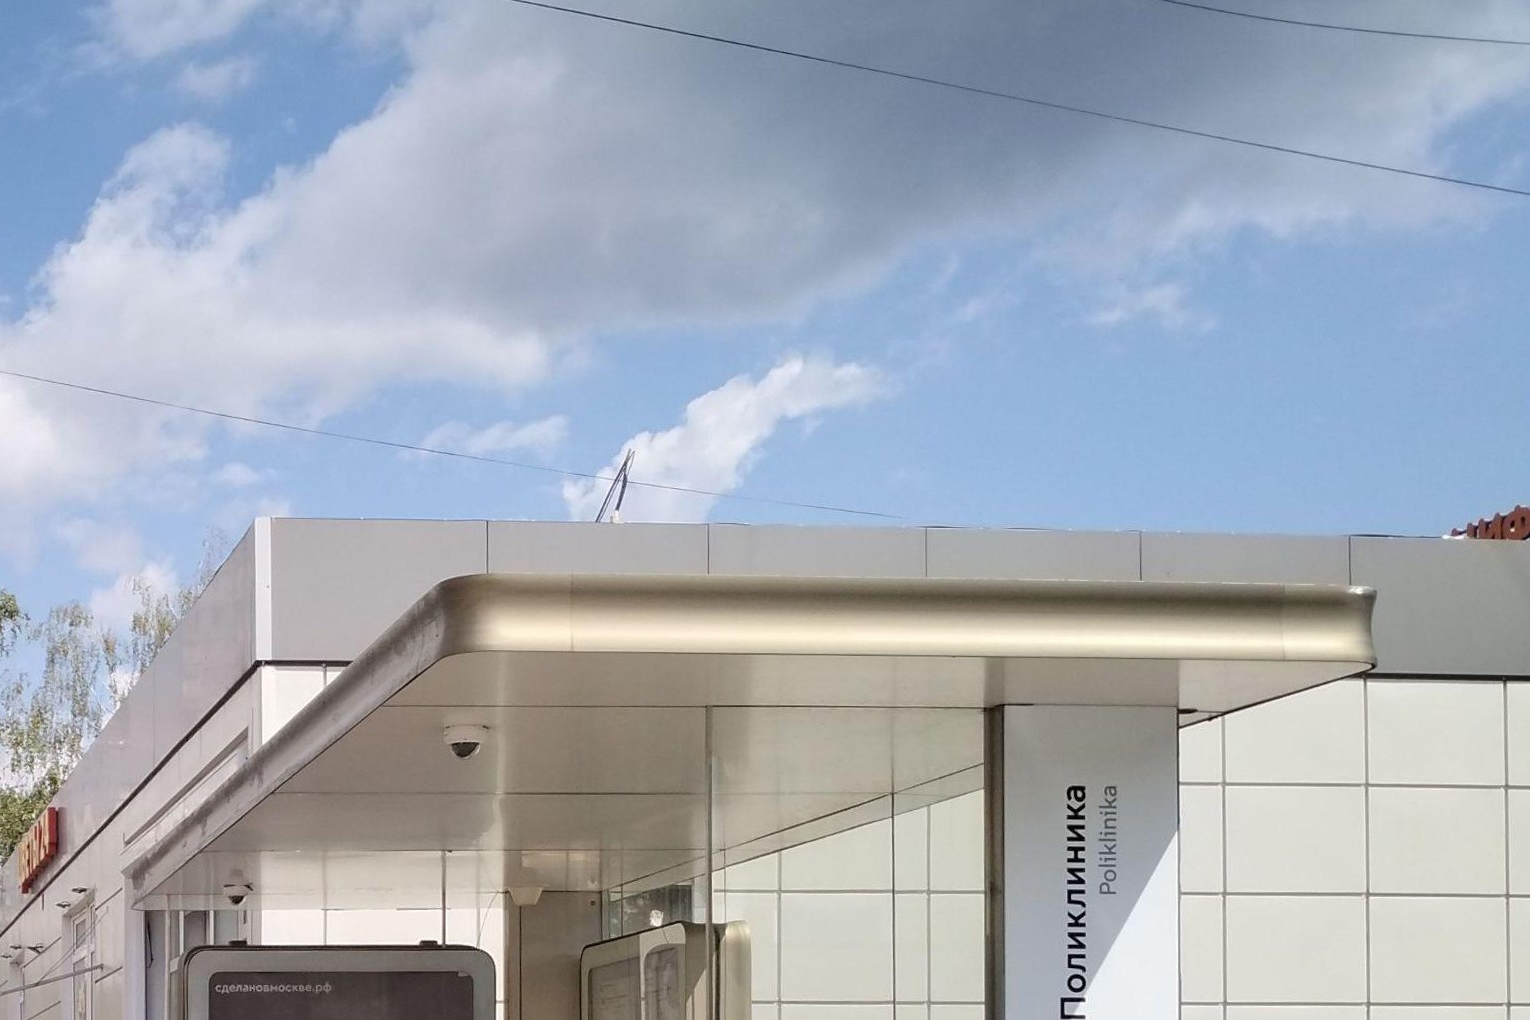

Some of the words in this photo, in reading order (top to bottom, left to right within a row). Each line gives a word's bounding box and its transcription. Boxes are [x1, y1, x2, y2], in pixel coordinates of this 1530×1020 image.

[1098, 784, 1118, 896] Poliklinika
[1060, 784, 1087, 1020] Поликлиника
[215, 982, 332, 995] сделановмоскве.рф
